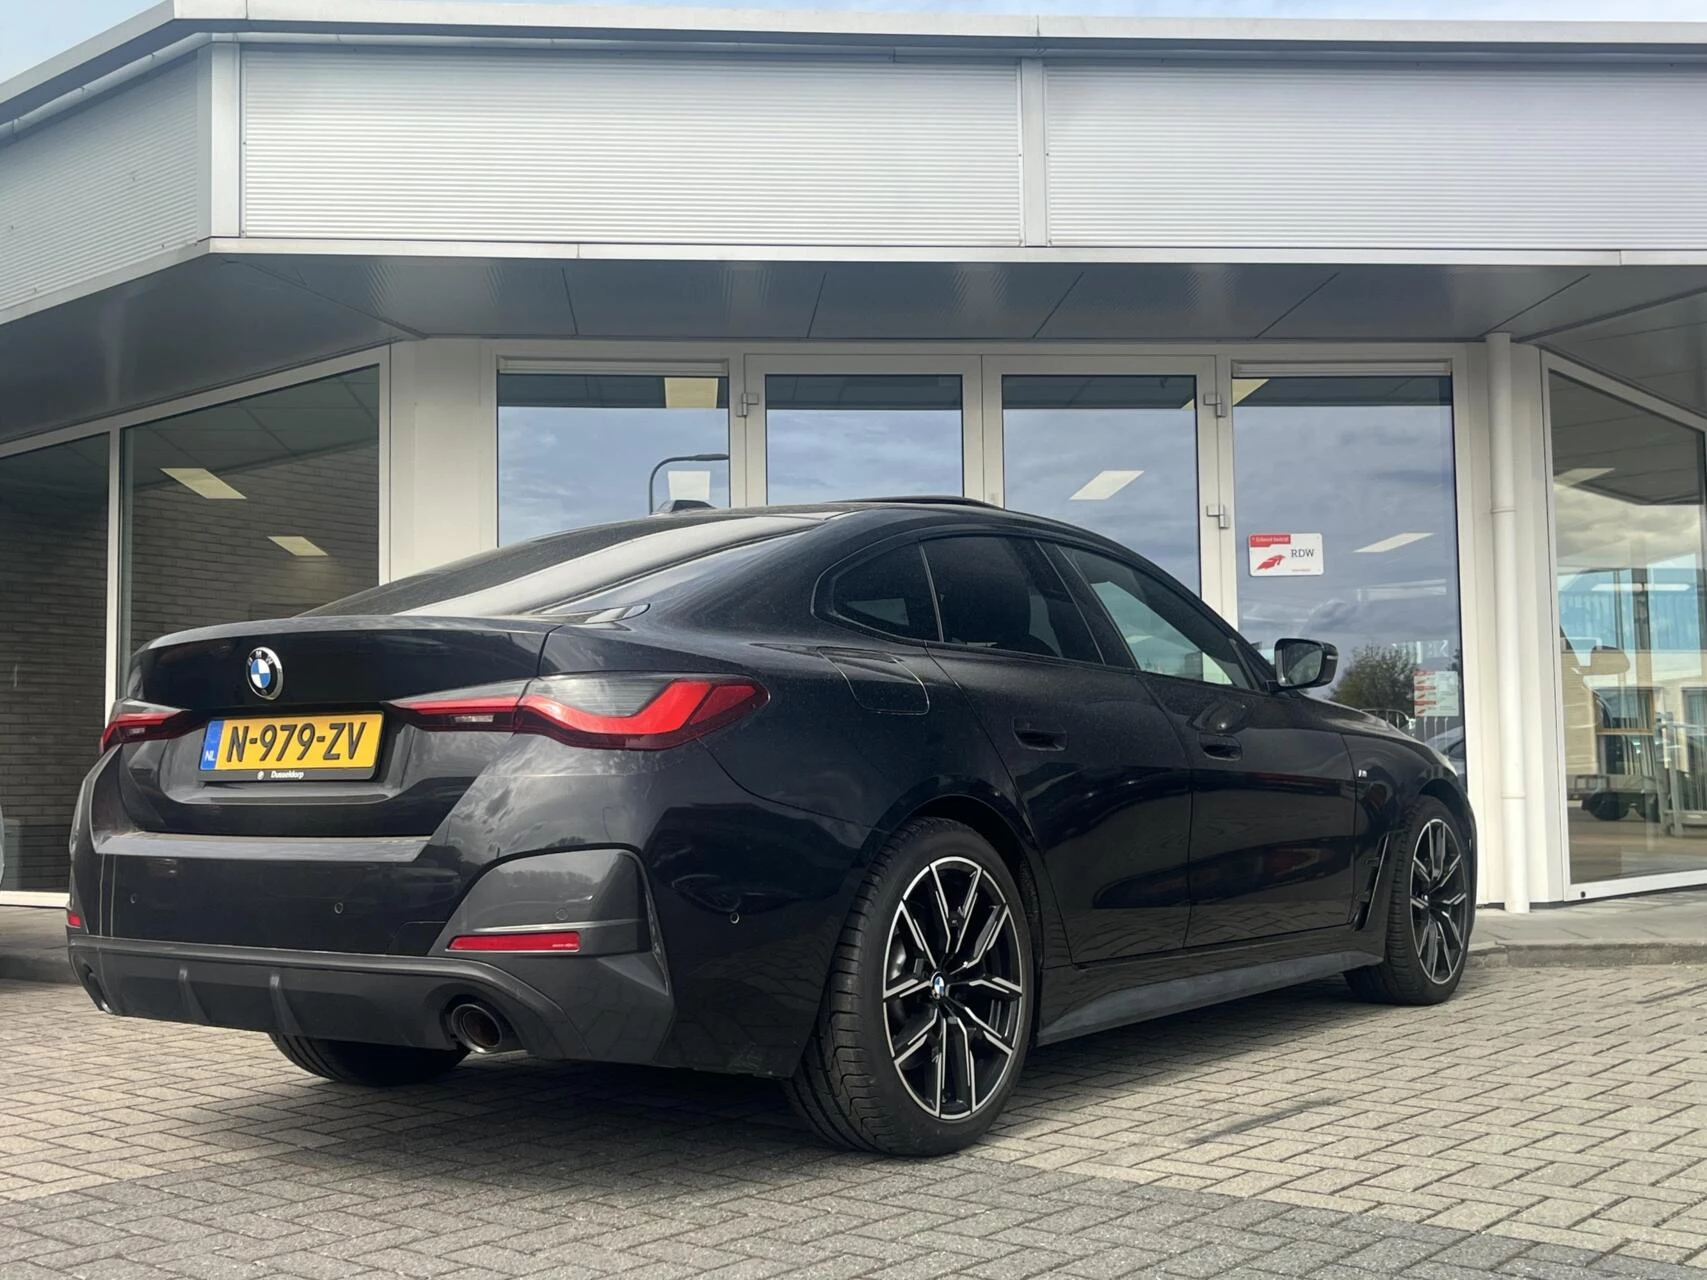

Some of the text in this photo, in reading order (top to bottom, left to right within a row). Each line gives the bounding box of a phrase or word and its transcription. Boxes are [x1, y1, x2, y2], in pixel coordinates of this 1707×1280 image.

[1291, 548, 1315, 558] RDW
[226, 721, 367, 763] N-979-ZV
[204, 750, 216, 762] NL
